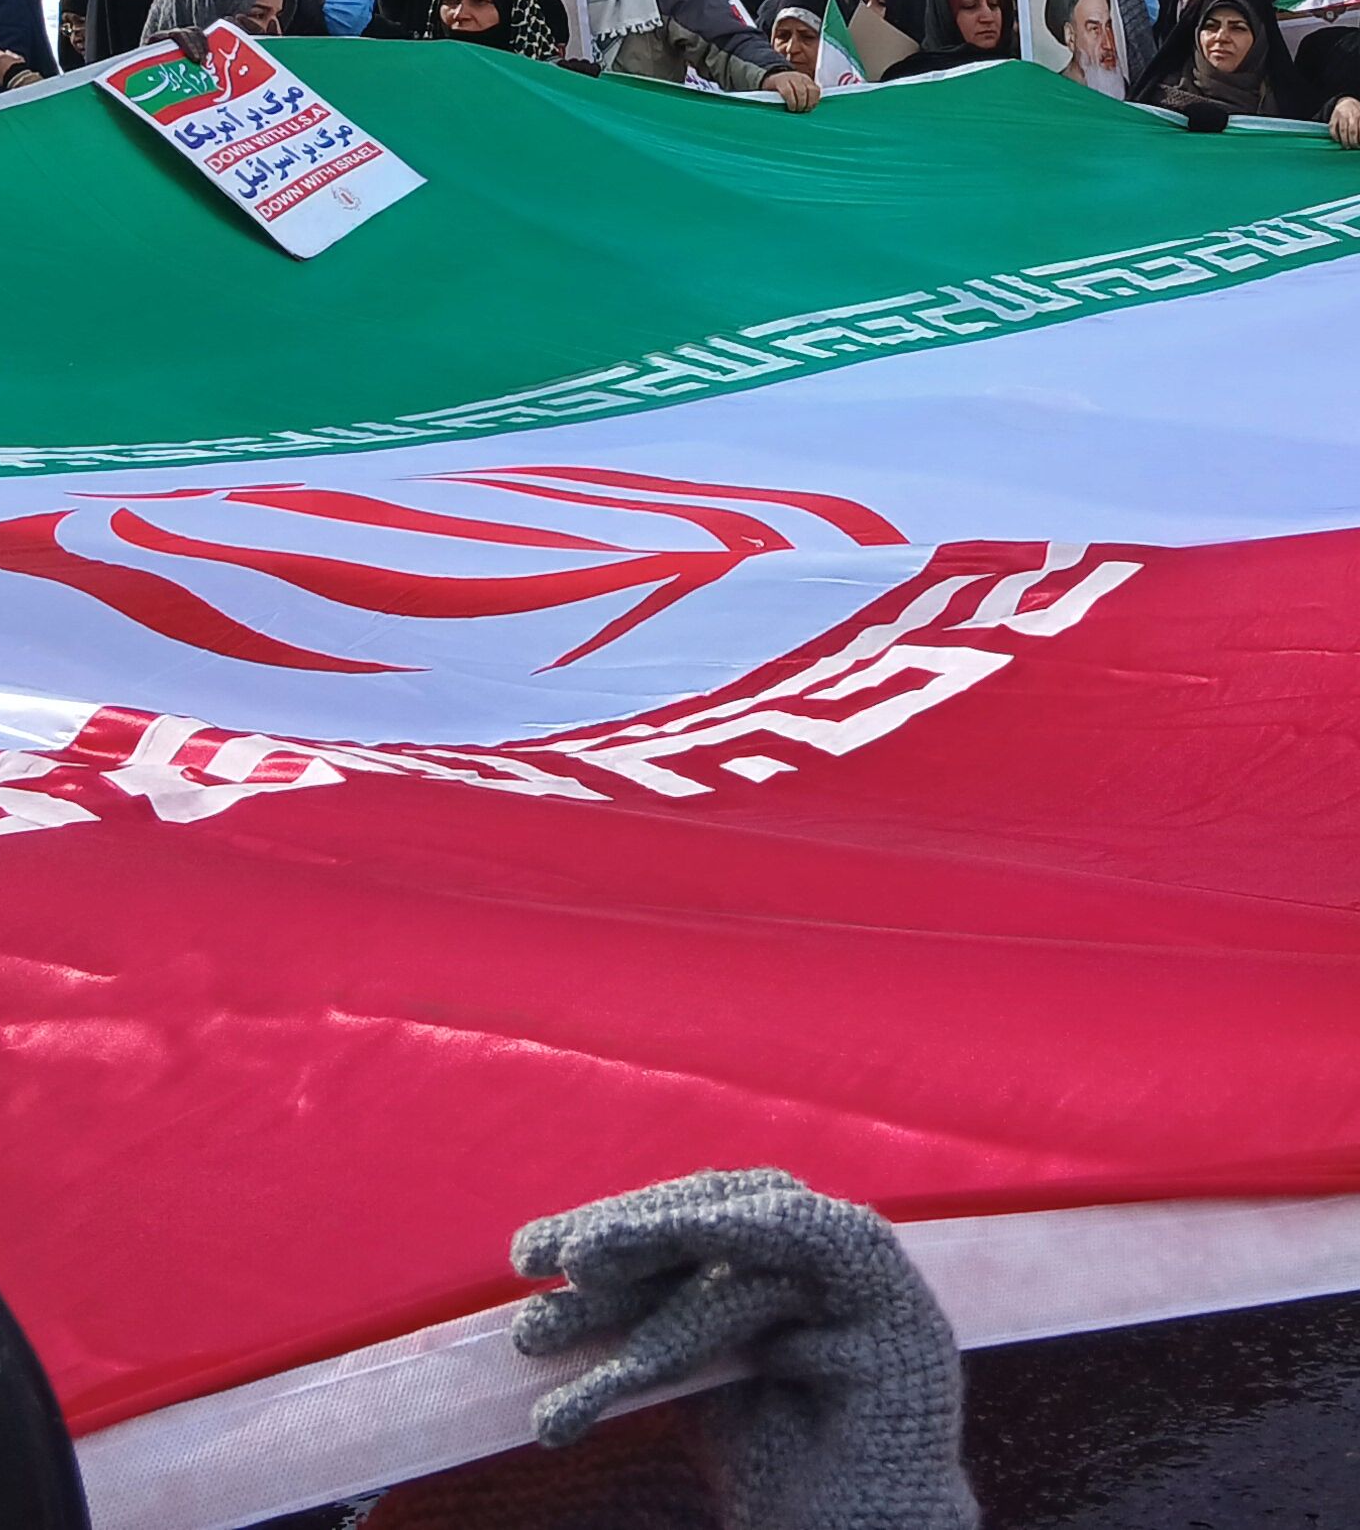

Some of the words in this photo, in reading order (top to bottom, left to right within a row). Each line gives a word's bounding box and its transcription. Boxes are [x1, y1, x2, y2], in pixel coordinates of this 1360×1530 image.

[246, 107, 271, 131] بر
[259, 86, 305, 115] مرگ
[174, 106, 246, 151] آمریکا
[206, 139, 253, 172] DOWN
[251, 126, 288, 151] WITH
[285, 108, 328, 135] U.S.A
[313, 124, 354, 149] مرگ
[301, 142, 324, 164] بر
[234, 145, 302, 200] اسرائیل
[258, 184, 305, 220] DOWN
[300, 167, 336, 194] WITH
[333, 146, 379, 177] ISRAEL
